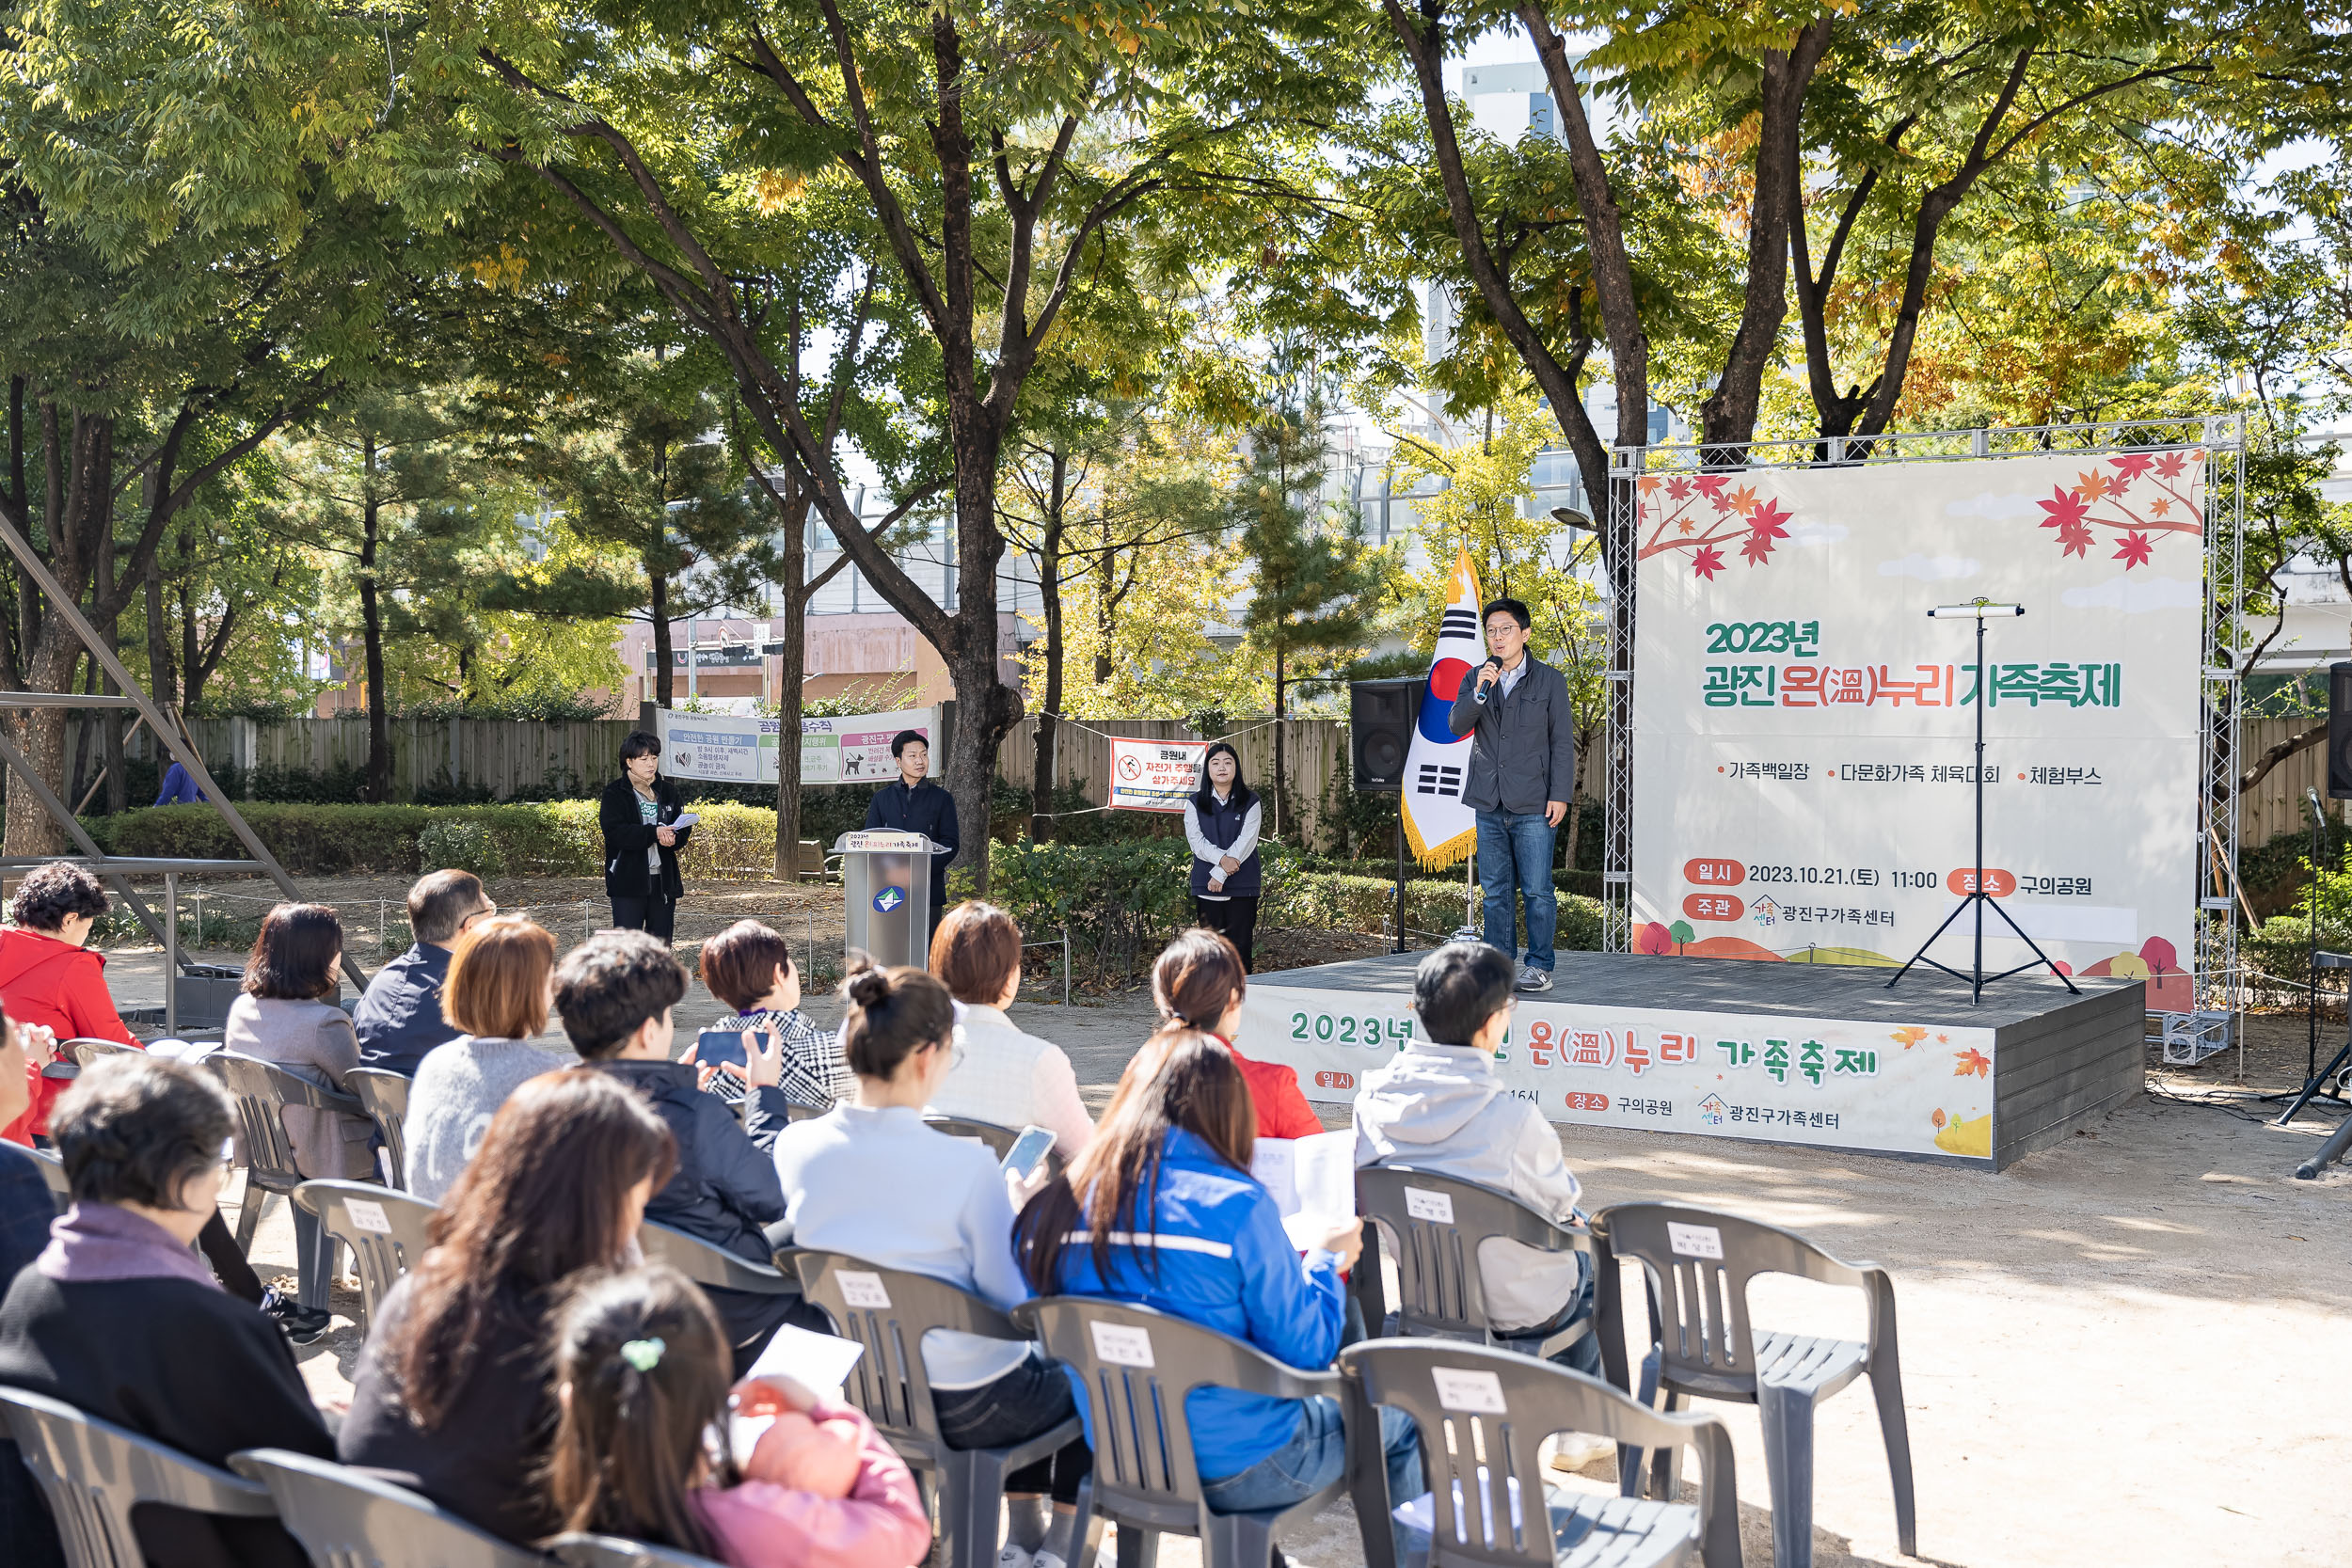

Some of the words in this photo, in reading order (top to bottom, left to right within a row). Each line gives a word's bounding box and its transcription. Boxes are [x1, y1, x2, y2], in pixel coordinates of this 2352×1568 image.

[1706, 620, 1820, 657] 2023년
[1703, 665, 1775, 707] 광진
[1960, 662, 2121, 708] 가족축제
[802, 721, 833, 733] 용수칙
[683, 733, 704, 743] 안전한
[706, 735, 719, 744] 공원
[721, 736, 742, 745] 만들기
[861, 735, 885, 745] 광진구
[1160, 750, 1186, 761] 공원내
[1145, 762, 1172, 773] 자전거
[1729, 762, 1809, 781] 가족백일장
[1841, 764, 1925, 783] 다문화가족
[2029, 767, 2102, 785] 체험부스
[1152, 775, 1196, 786] 삼가주세요
[1698, 863, 1732, 881] 일시
[1749, 865, 1880, 887] 2023.10.21.(토)
[1892, 871, 1937, 888] 11:00
[2021, 876, 2091, 895] 구의공원
[1697, 898, 1731, 916] 주관
[1782, 906, 1895, 927] 광진구가족센터
[1717, 1039, 1875, 1085] 가족축제
[1322, 1072, 1350, 1088] 일시
[1574, 1094, 1605, 1110] 장소
[1617, 1097, 1672, 1117] 구의공원
[1729, 1105, 1839, 1129] 광진구가족센터
